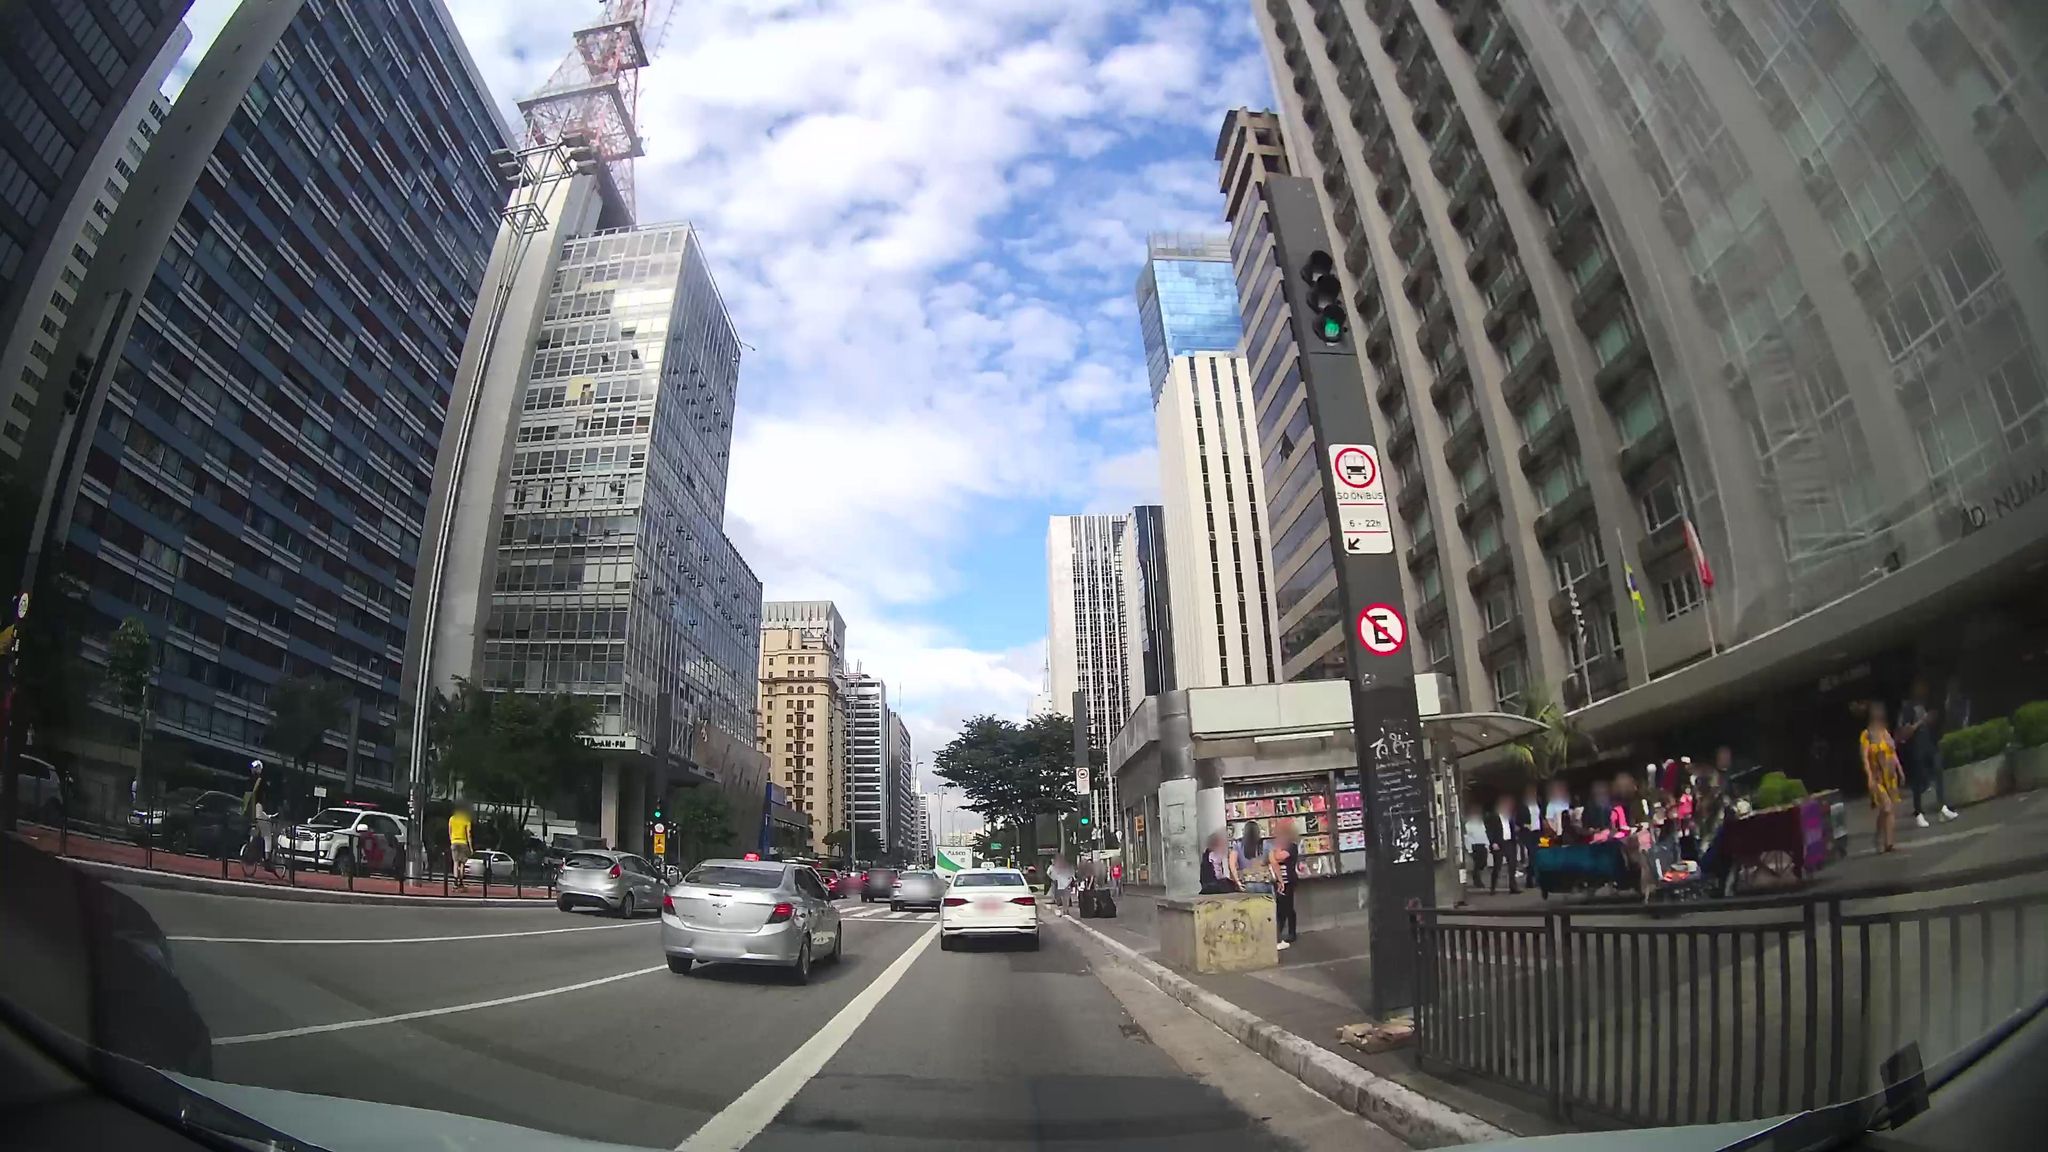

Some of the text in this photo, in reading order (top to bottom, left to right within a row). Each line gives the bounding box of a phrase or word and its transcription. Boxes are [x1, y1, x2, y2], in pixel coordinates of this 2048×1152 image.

[1349, 519, 1356, 527] 6
[1365, 519, 1382, 528] 22h
[1371, 615, 1392, 645] E
